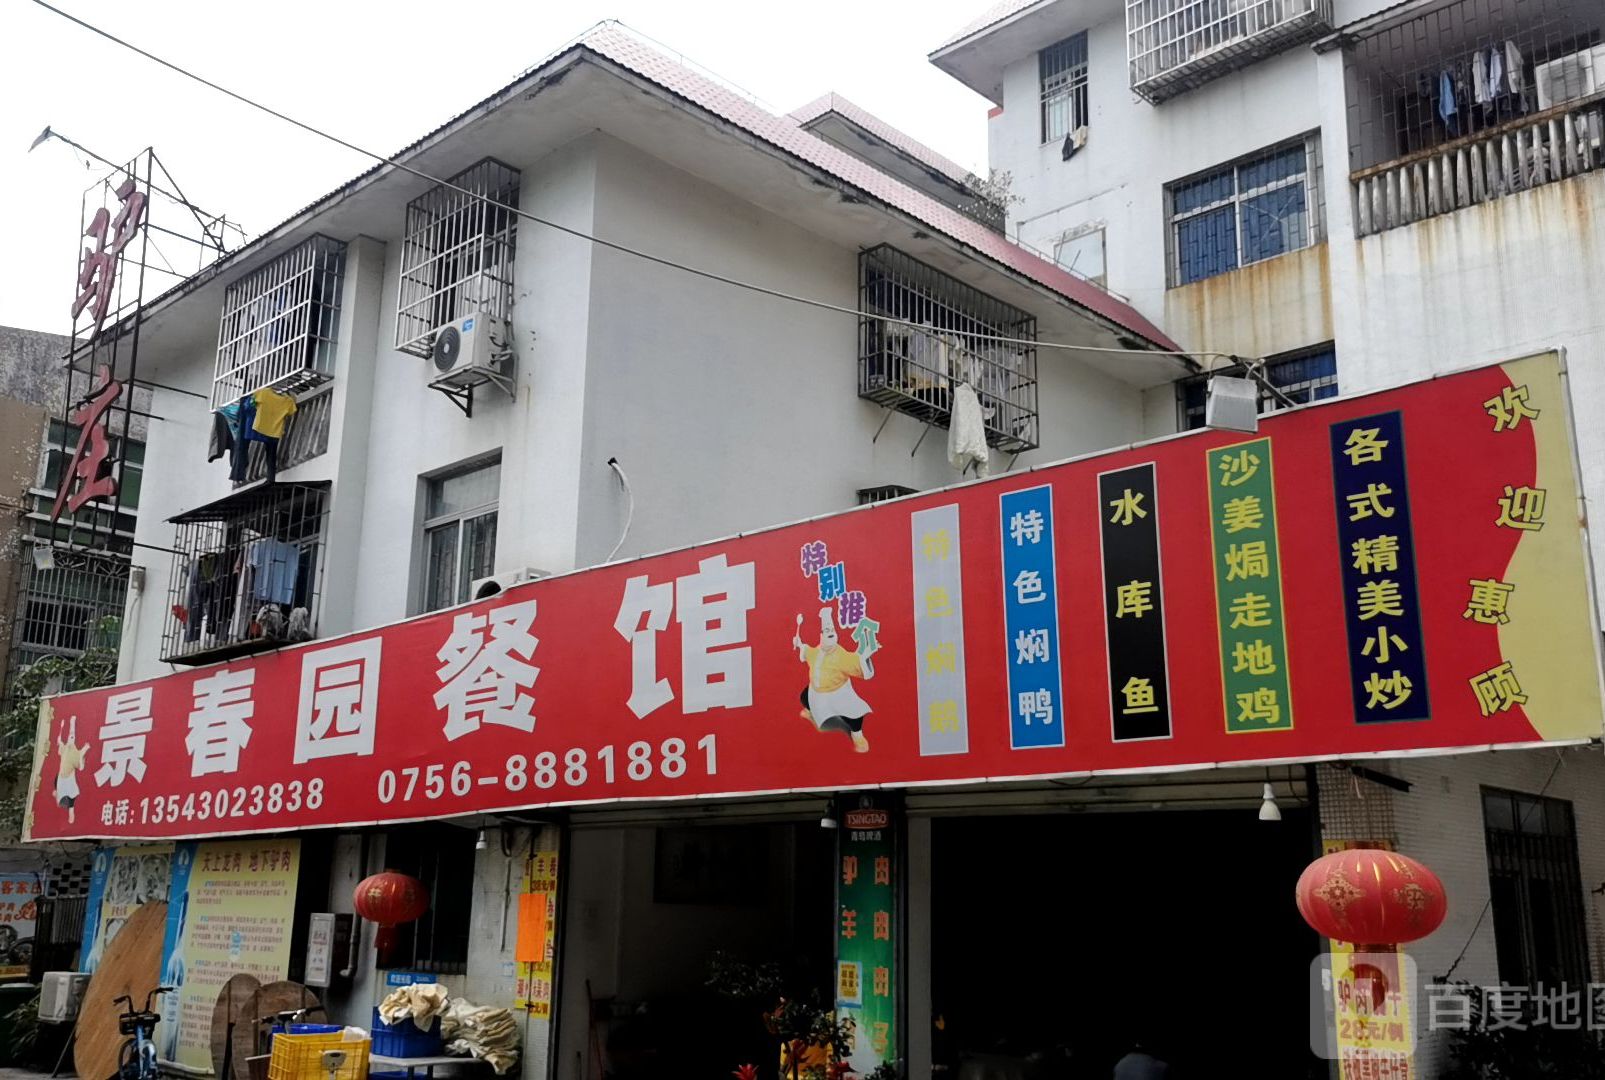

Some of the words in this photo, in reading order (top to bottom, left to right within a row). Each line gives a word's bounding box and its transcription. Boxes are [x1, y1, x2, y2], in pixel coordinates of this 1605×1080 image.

[801, 540, 880, 655] 特别推介
[1010, 510, 1053, 726] 特色焖鸭
[1109, 488, 1160, 715] 水库鱼
[1218, 450, 1280, 723] 沙姜焗走地鸡
[1343, 428, 1412, 710] 各式精美小炒
[1463, 384, 1546, 717] 欢迎惠顾
[94, 553, 757, 788] 景春园餐馆
[378, 734, 717, 804] 0756-8881881
[101, 778, 324, 826] 电话:13543023838
[847, 813, 888, 825] TSINGTAO
